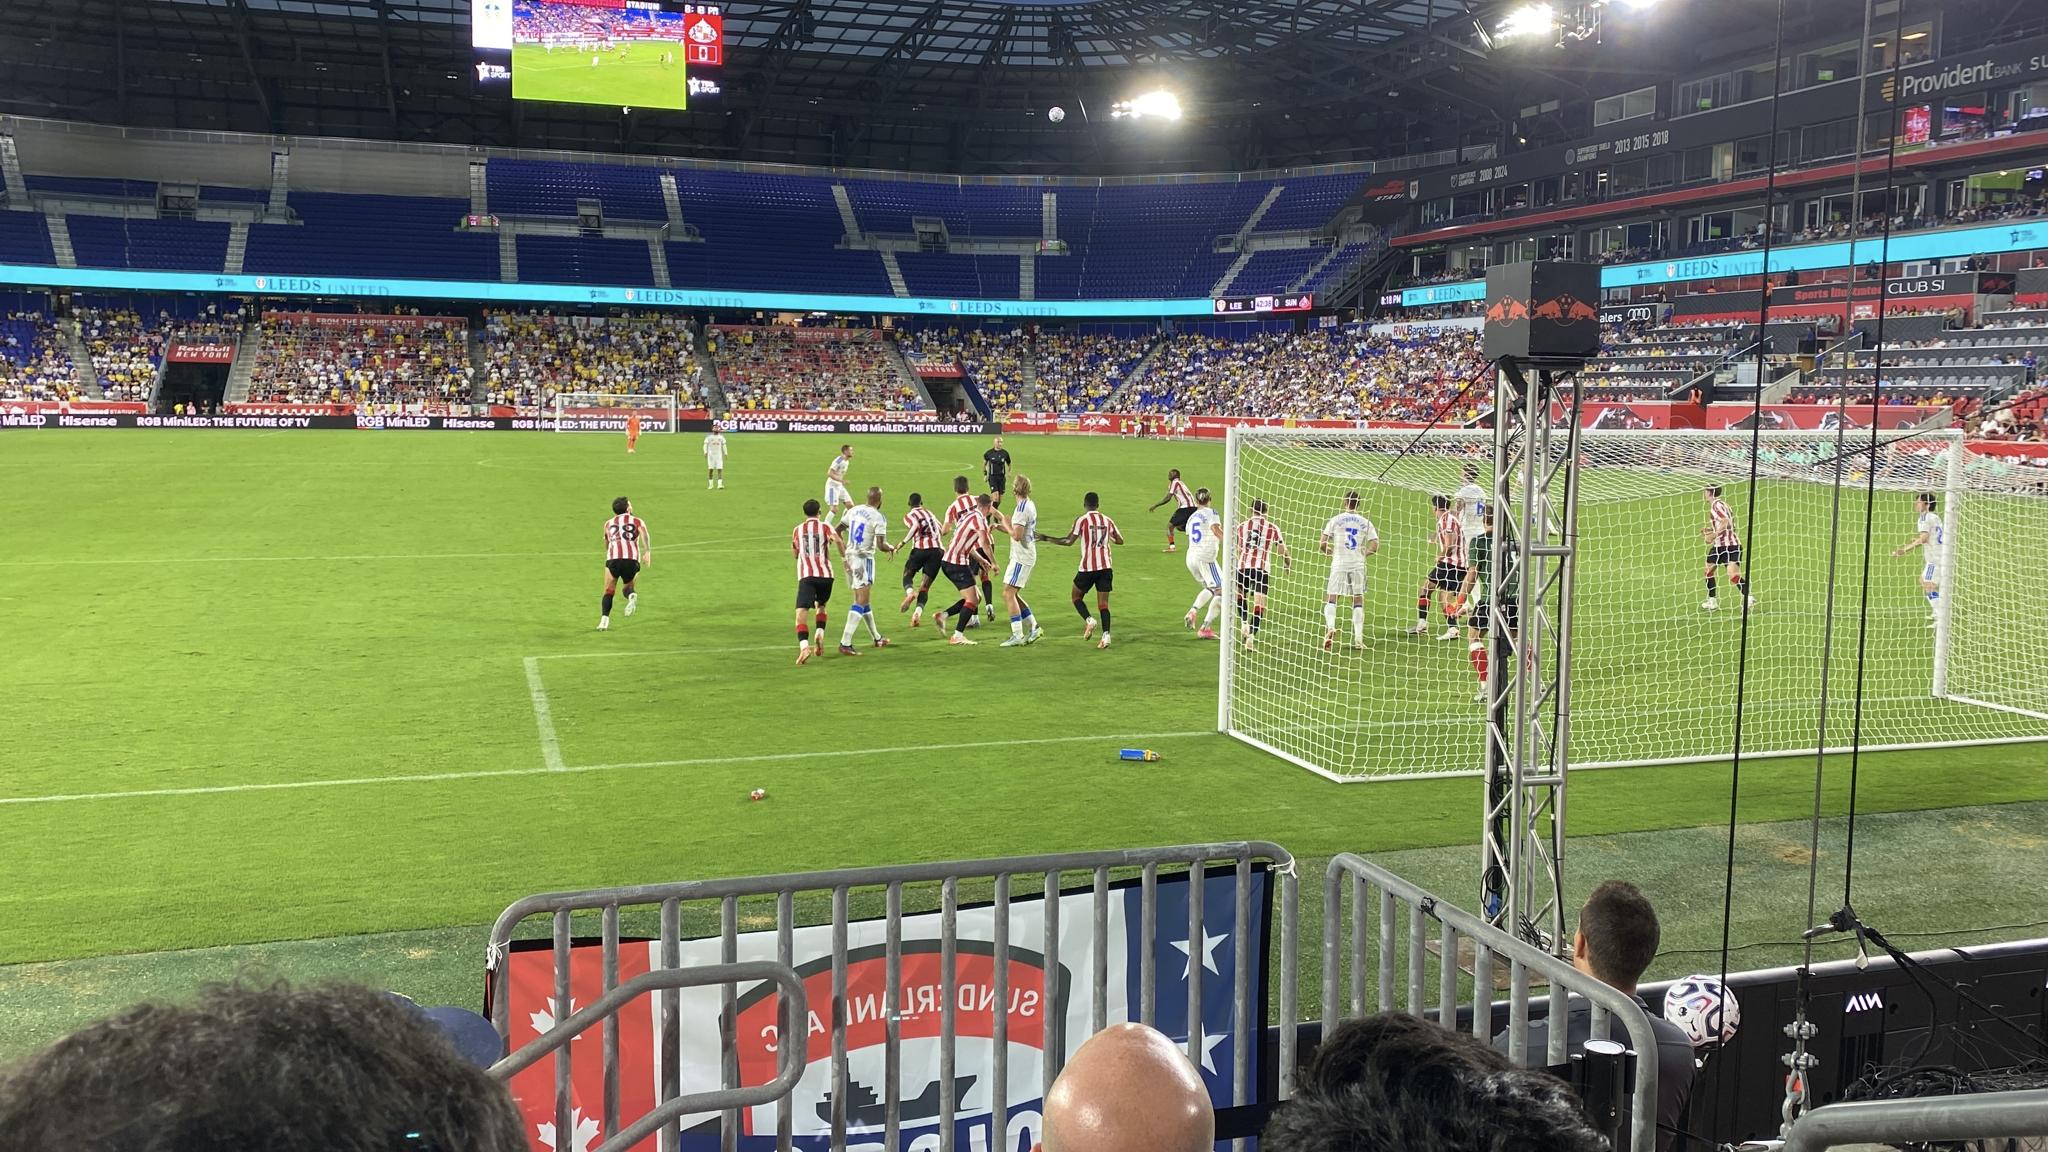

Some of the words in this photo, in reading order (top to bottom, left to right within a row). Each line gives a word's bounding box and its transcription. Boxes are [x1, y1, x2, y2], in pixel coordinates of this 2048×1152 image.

[698, 45, 708, 60] 0
[1902, 60, 1994, 97] Provident
[1993, 62, 2024, 79] BANK
[1614, 138, 1631, 154] 2013
[1633, 134, 1650, 151] 2015
[1652, 130, 1669, 147] 2018
[1676, 259, 1719, 278] LEEDS
[269, 279, 321, 291] LEEDS
[328, 284, 389, 295] UNITED
[1795, 290, 1829, 300] Sports
[1888, 281, 1929, 294] CLUB
[1931, 280, 1945, 291] SI
[637, 291, 683, 302] LEEDS
[689, 296, 744, 308] UNITED
[1229, 302, 1242, 310] LEE
[1285, 299, 1297, 307] SUN
[960, 301, 1001, 313] LEEDS
[1006, 306, 1058, 316] UNITED
[1600, 312, 1623, 323] alers
[3, 415, 46, 426] MiniLED
[59, 415, 118, 426] Hisense
[136, 416, 161, 426] RGB
[163, 416, 211, 427] MiniLED:
[213, 417, 234, 427] THE
[236, 417, 277, 427] FUTURE
[279, 418, 293, 427] OF
[295, 418, 310, 427] TV
[356, 416, 385, 427] RGB
[387, 416, 430, 428] MiniLED
[443, 418, 495, 428] Hisense
[512, 419, 533, 429] RGB
[580, 420, 598, 429] THE
[600, 420, 628, 430] FUTU
[654, 421, 666, 430] TV
[740, 421, 778, 431] MiniLED
[789, 422, 835, 432] Hisense
[850, 424, 868, 432] RGB
[870, 424, 907, 432] MiniLED:
[908, 424, 924, 433] THE
[926, 424, 957, 433] FUTURE
[959, 425, 970, 433] OF
[972, 425, 983, 433] TV
[609, 523, 636, 541] 28
[851, 520, 865, 544] 14
[1089, 525, 1108, 547] 17
[1191, 522, 1201, 543] 5
[1345, 527, 1358, 550] 3
[802, 534, 820, 555] 11
